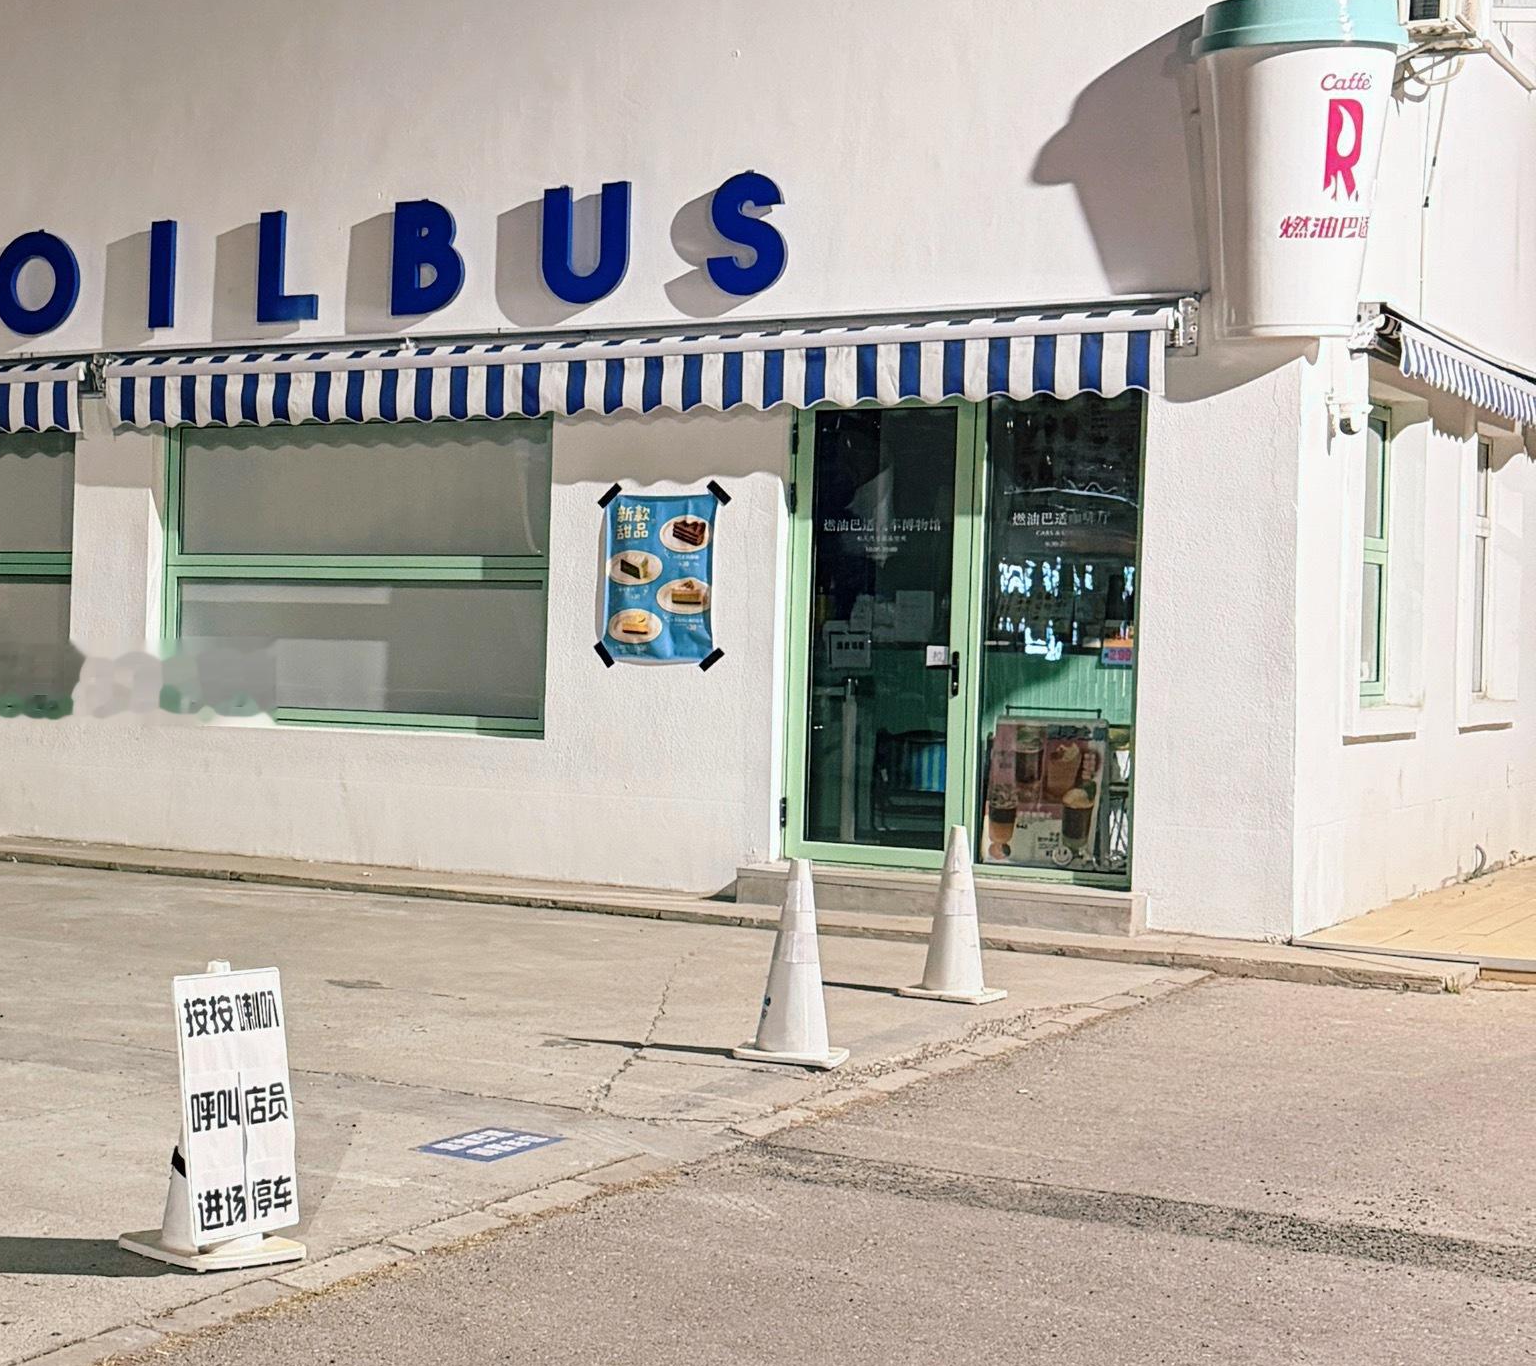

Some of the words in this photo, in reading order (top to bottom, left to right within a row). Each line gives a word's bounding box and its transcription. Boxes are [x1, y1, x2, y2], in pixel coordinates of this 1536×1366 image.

[616, 523, 649, 540] 甜品
[184, 990, 281, 1038] 按按喇叭
[190, 1081, 289, 1133] 呼叫店员
[197, 1175, 293, 1232] 进场停车
